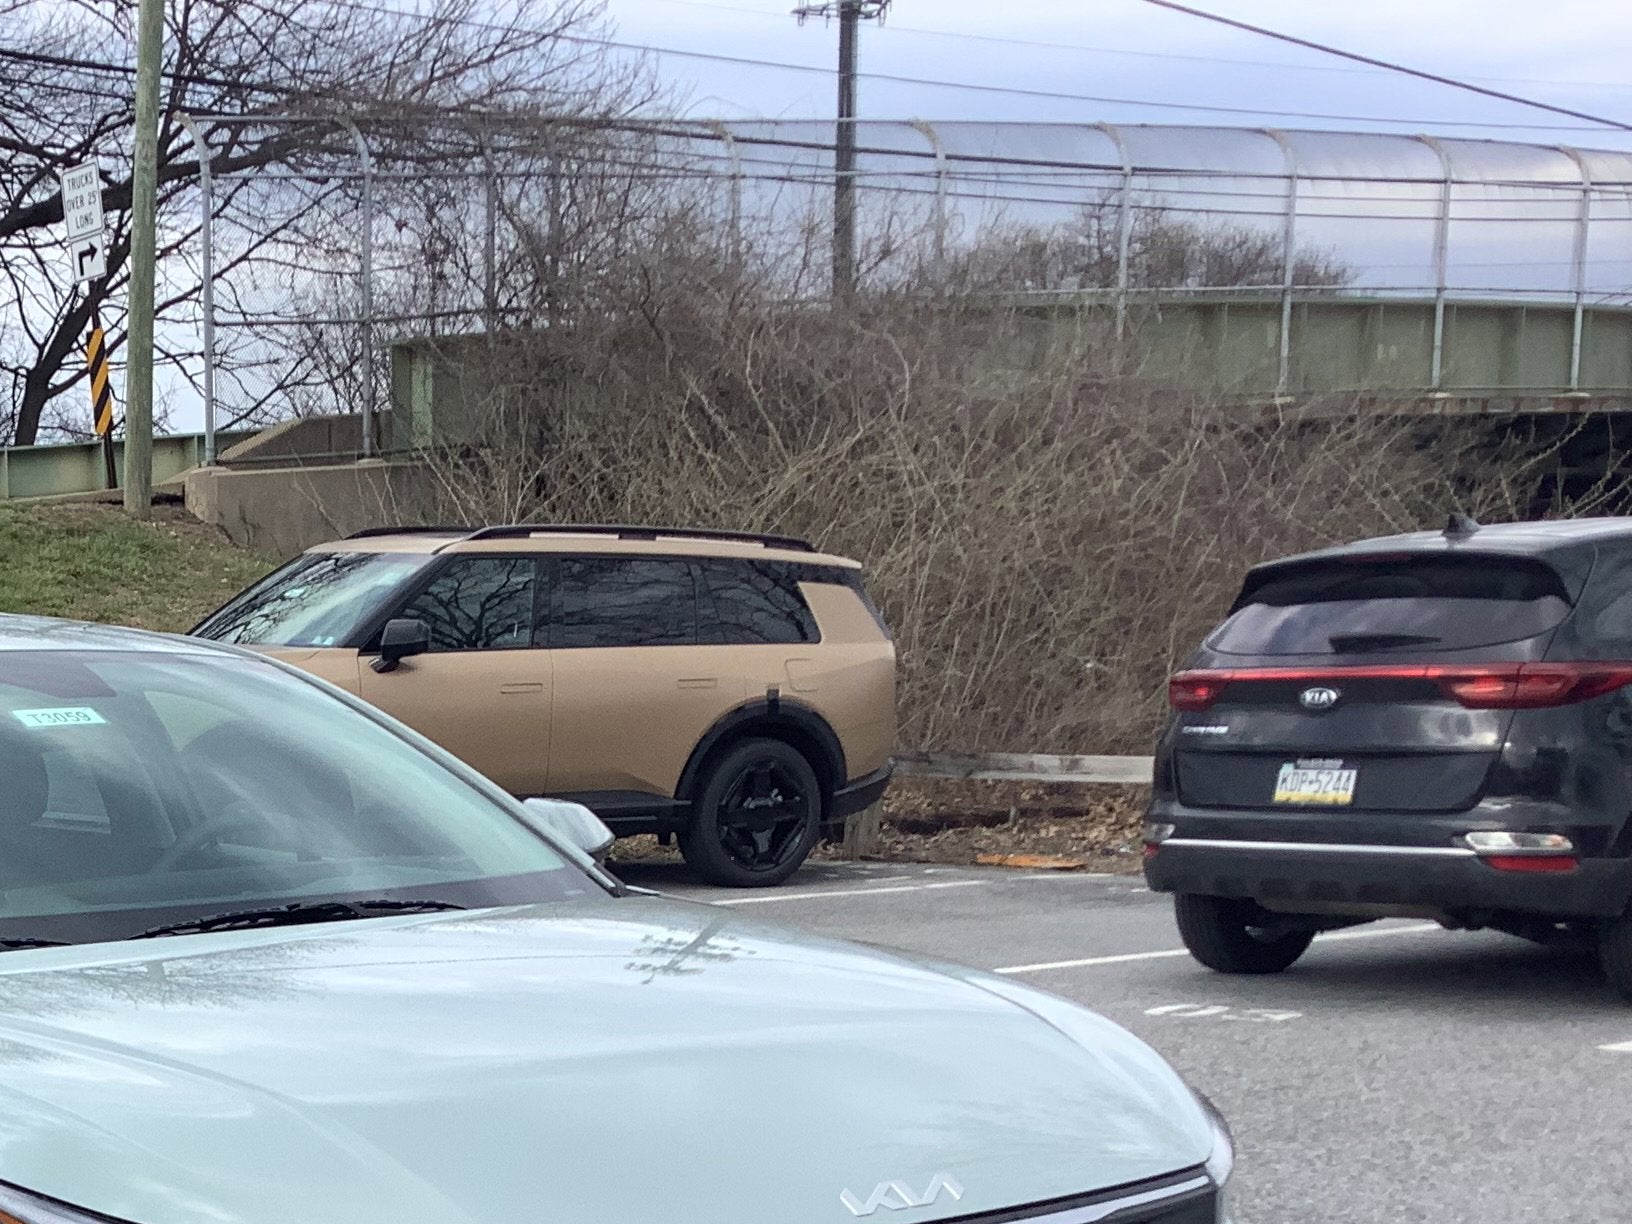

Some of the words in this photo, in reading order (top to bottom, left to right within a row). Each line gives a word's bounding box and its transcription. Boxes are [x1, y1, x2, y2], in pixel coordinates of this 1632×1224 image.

[67, 171, 94, 190] TRUCKS
[66, 194, 85, 212] OVER
[76, 211, 94, 229] LONG
[1303, 689, 1333, 705] KIA
[26, 711, 92, 724] T3059
